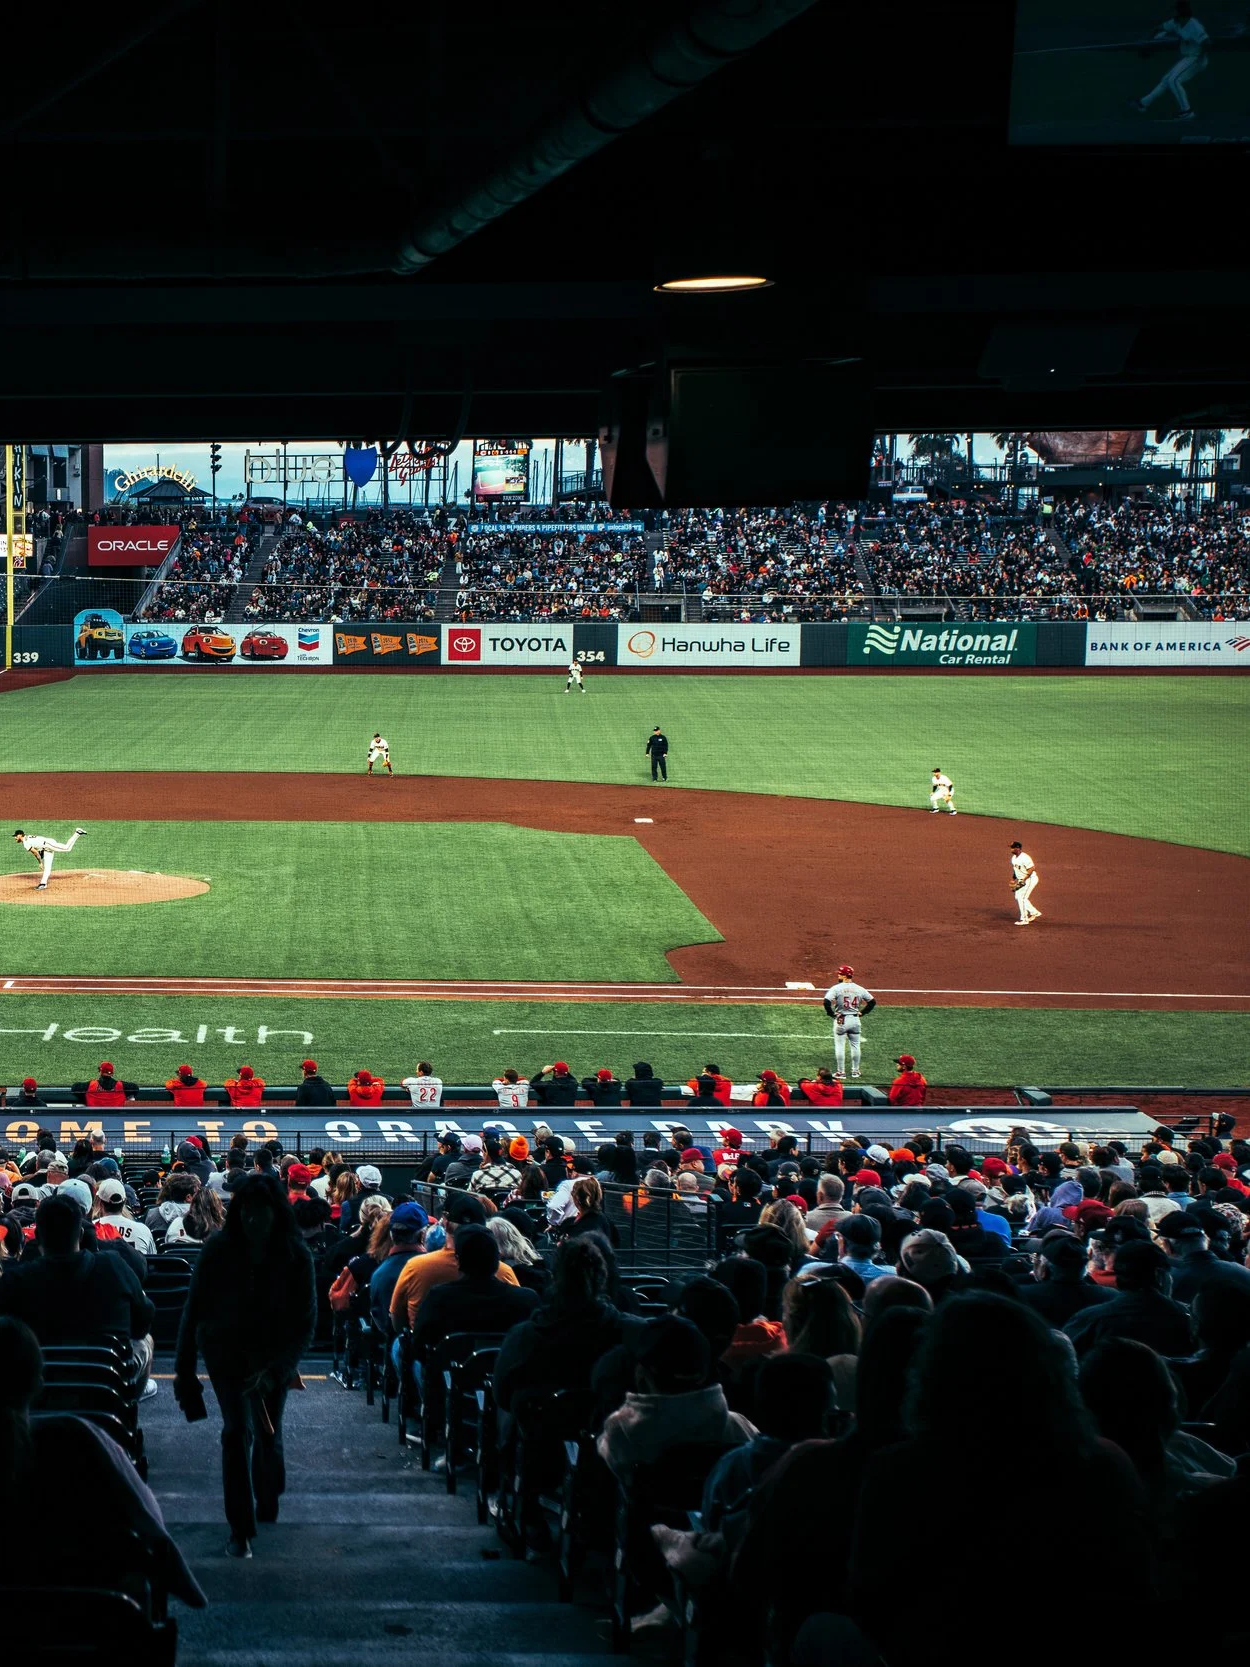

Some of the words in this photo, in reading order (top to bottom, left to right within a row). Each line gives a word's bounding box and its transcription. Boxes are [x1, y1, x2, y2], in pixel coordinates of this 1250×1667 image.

[246, 449, 336, 484] blue
[114, 463, 198, 492] Ghirardelli
[98, 540, 168, 551] ORACLE
[488, 637, 567, 651] TOYOTA
[662, 637, 745, 652] Hanwha
[751, 637, 790, 652] Life
[900, 629, 1018, 651] National
[1090, 642, 1129, 651] BANK
[1133, 642, 1151, 651] OF
[1155, 642, 1221, 651] AMERICA
[12, 651, 39, 663] 339
[576, 650, 605, 662] 354
[939, 654, 962, 664] Car
[965, 654, 1011, 664] Rental
[843, 996, 858, 1009] 54
[419, 1087, 437, 1102] 22
[511, 1093, 519, 1108] 9
[197, 1120, 278, 1143] TO
